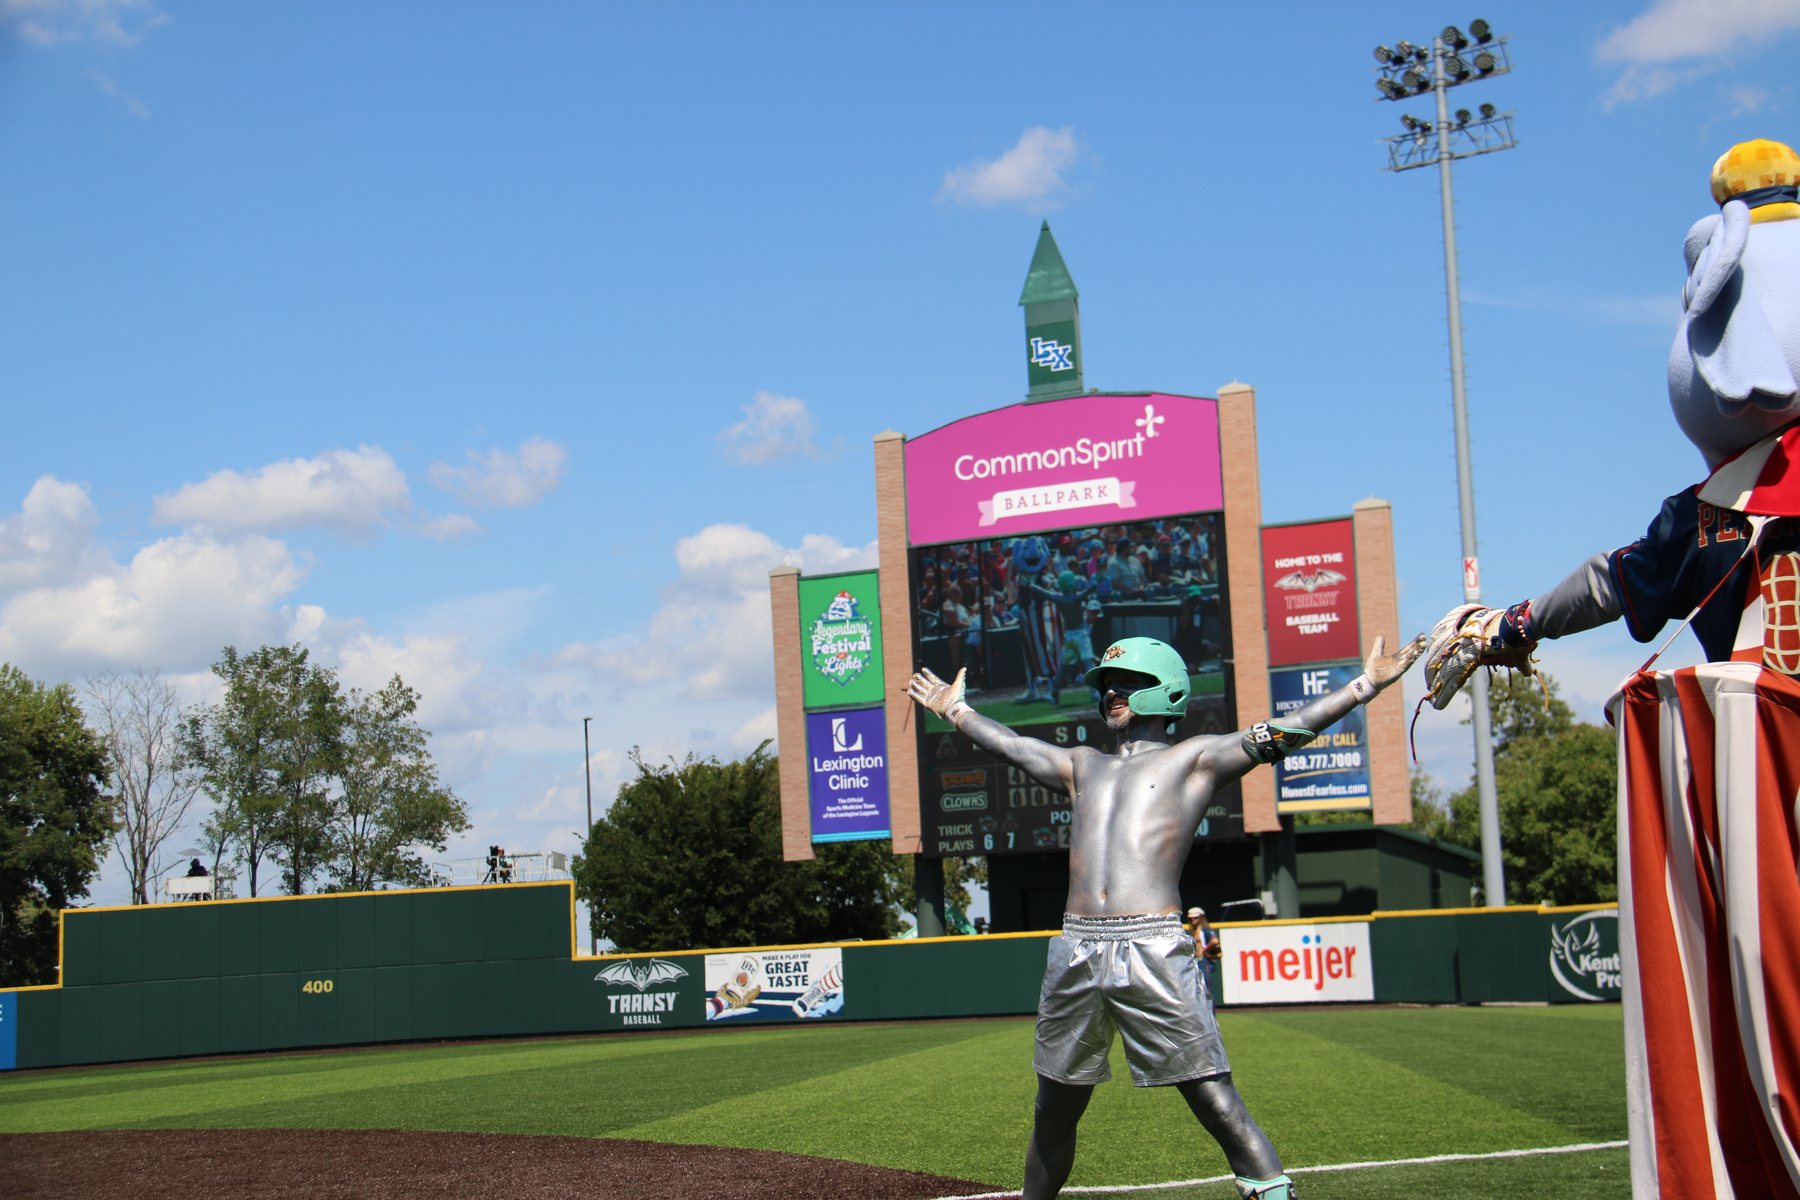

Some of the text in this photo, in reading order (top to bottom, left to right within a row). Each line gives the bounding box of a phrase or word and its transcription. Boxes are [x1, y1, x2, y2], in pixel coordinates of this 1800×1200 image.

[1030, 337, 1073, 371] LEX
[954, 432, 1145, 481] CommonSpirit
[1005, 485, 1108, 510] BALLPARK
[1274, 552, 1344, 569] HOME TO THE
[1285, 612, 1340, 626] BASEBALL
[1298, 623, 1329, 635] TEAM
[812, 636, 871, 655] Festival
[821, 655, 862, 675] Lights
[1055, 725, 1087, 743] S 0
[1332, 732, 1358, 746] CALL
[813, 754, 884, 773] Lexington
[1284, 752, 1361, 771] 859.777.7000
[828, 773, 869, 790] Clinic
[1281, 783, 1368, 799] HonestFearless.com
[943, 794, 985, 810] CLOWNS
[1050, 810, 1072, 824] PO
[937, 823, 973, 836] TRICK
[938, 840, 974, 852] PLAYS
[983, 832, 1015, 850] 6 7
[765, 961, 808, 974] GREAT
[1239, 935, 1356, 990] meijer
[1579, 953, 1620, 972] Kent
[303, 980, 333, 993] 400
[767, 975, 809, 987] TASTE
[607, 992, 676, 1013] TRANSY
[623, 1015, 661, 1025] BASEBALL
